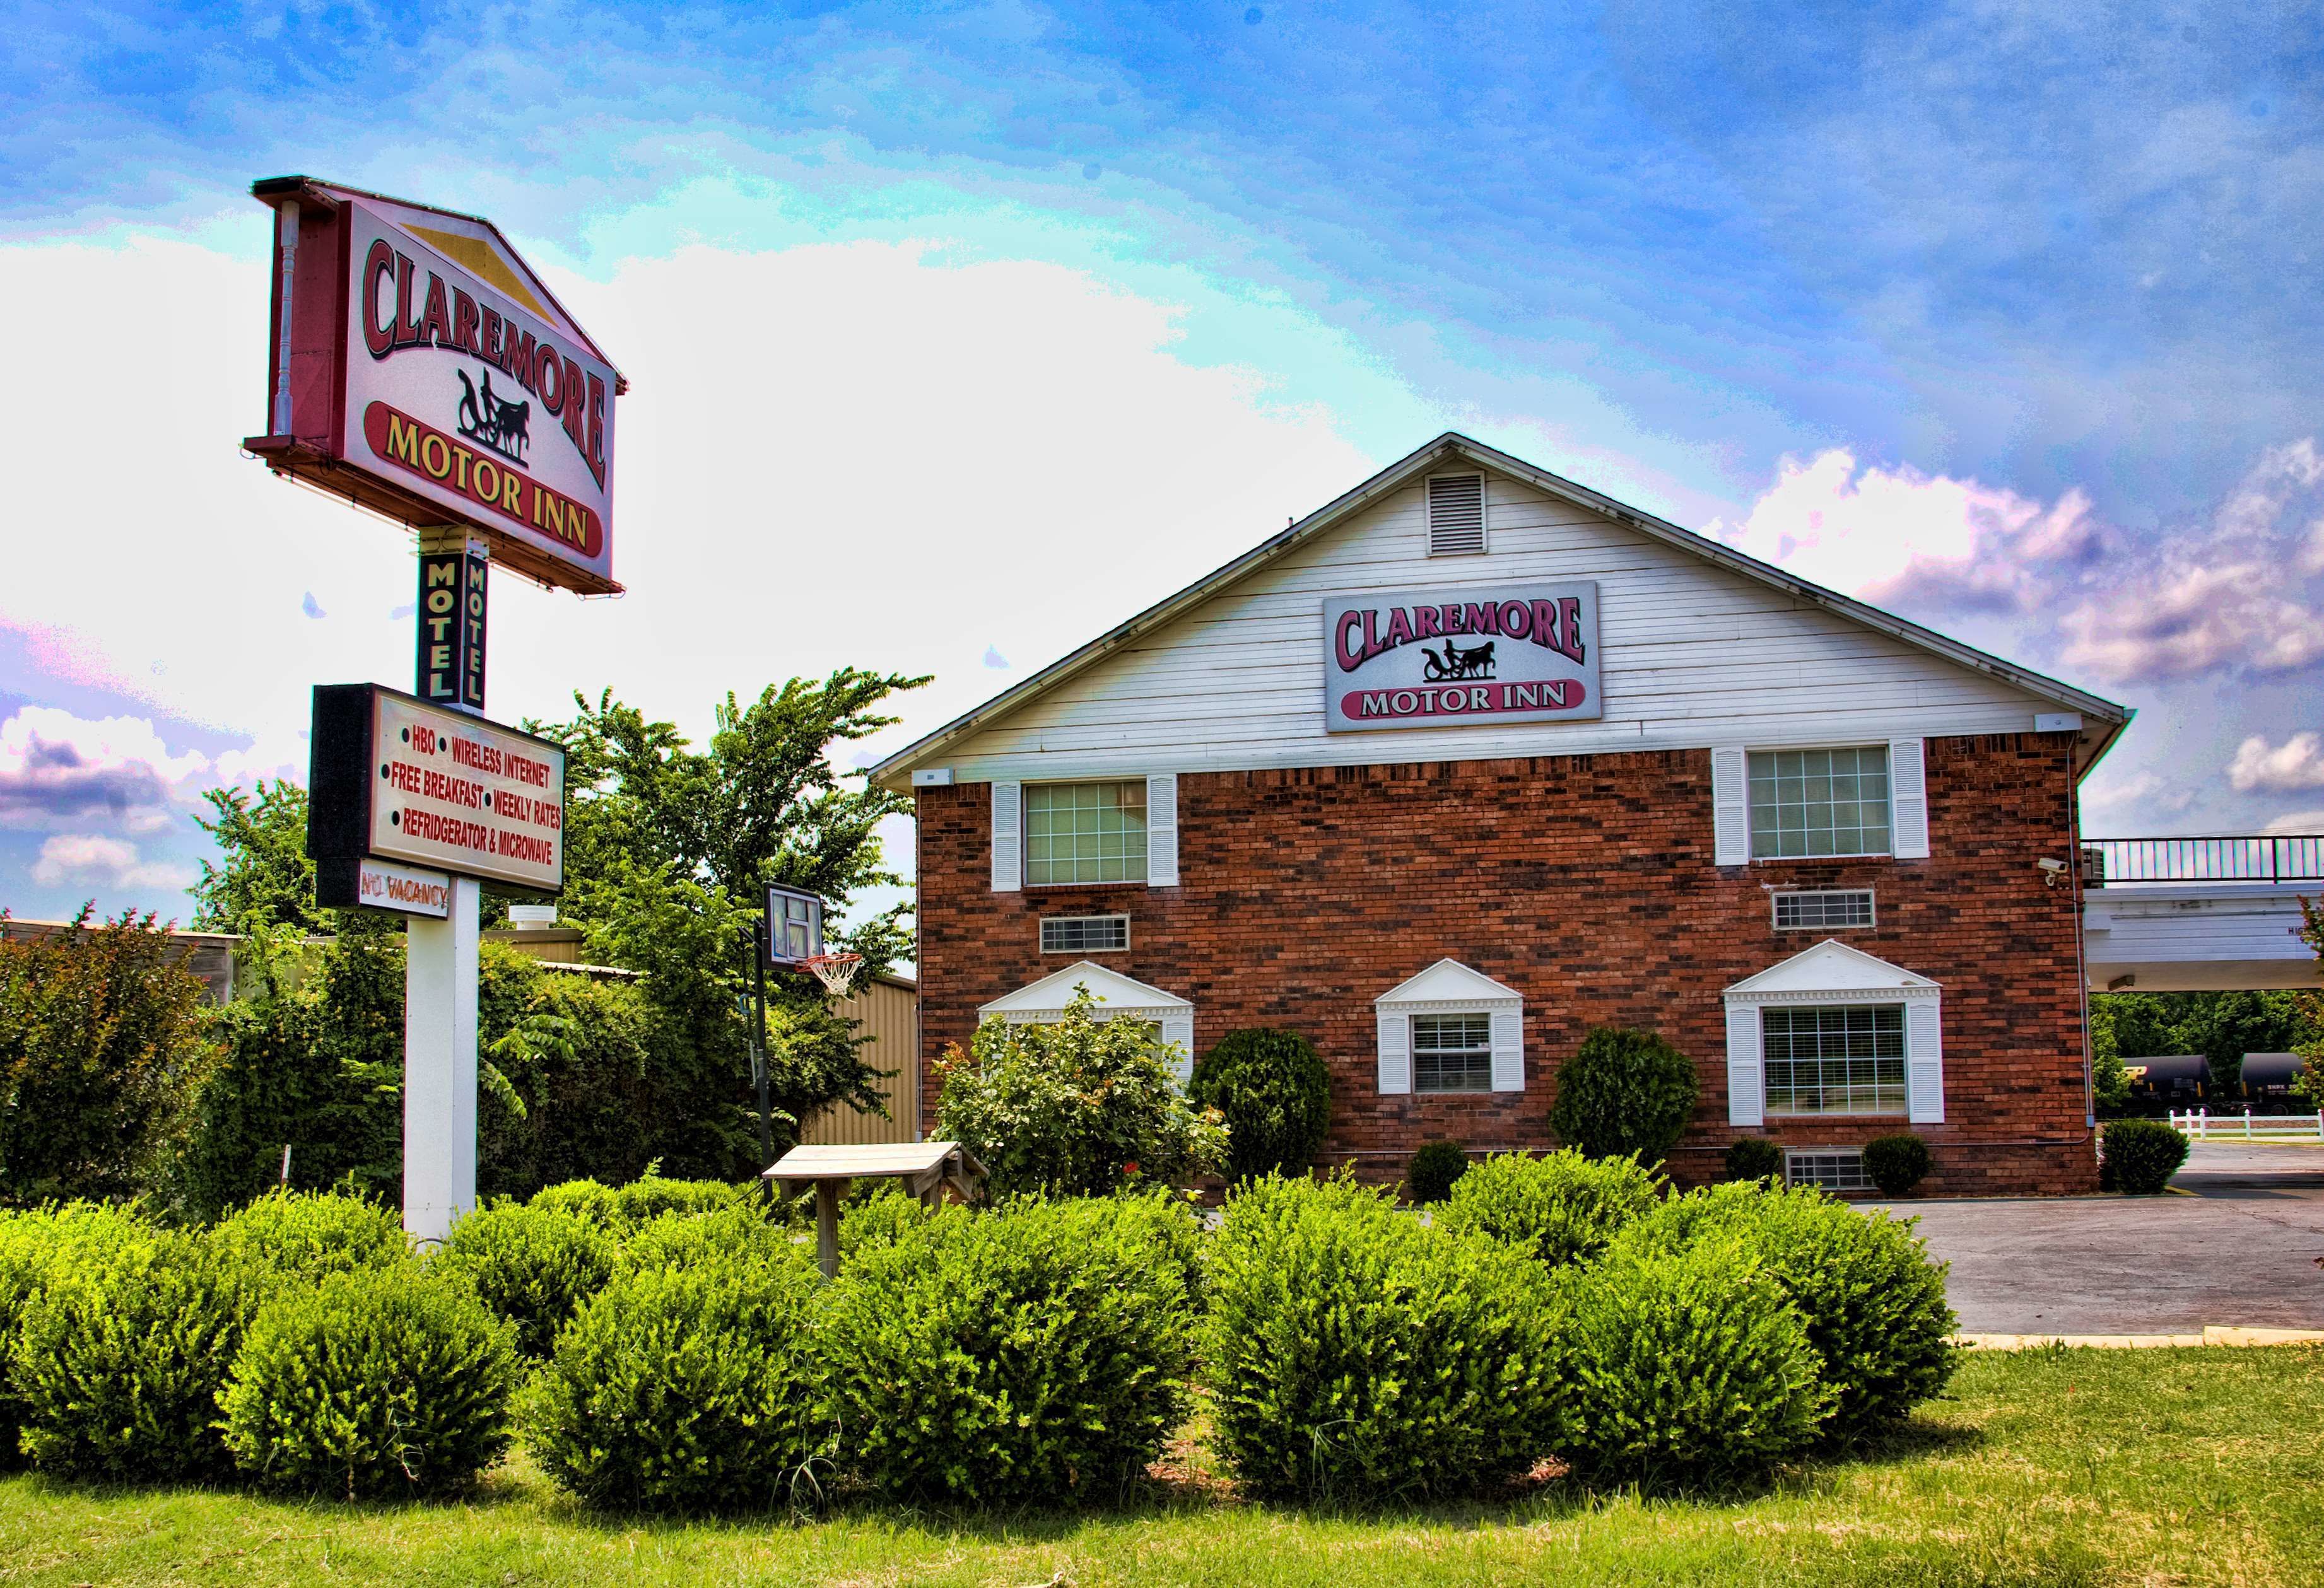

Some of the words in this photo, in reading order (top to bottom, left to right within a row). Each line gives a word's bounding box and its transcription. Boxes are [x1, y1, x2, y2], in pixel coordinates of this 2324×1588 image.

[363, 238, 606, 494] CLAREMORE
[387, 412, 524, 521] MOTOR
[532, 488, 587, 552] INN
[427, 562, 455, 697] MOTEL
[469, 564, 484, 701] MOTEL
[1335, 597, 1586, 673] CLAREMORE
[1360, 687, 1493, 717] MOTOR
[1502, 682, 1566, 709] INN
[413, 725, 435, 756] HBO
[452, 736, 502, 774] WIRELESS
[504, 752, 550, 788] INTERNET
[391, 761, 421, 794] FREE
[423, 769, 484, 810] BREAKFAST
[493, 789, 532, 822] WEEKLY
[534, 800, 561, 831] RATES
[403, 807, 486, 851] REFRIDGERATOR
[489, 828, 496, 853] &
[498, 830, 552, 865] MICROWAVE
[387, 875, 448, 909] VACANCY
